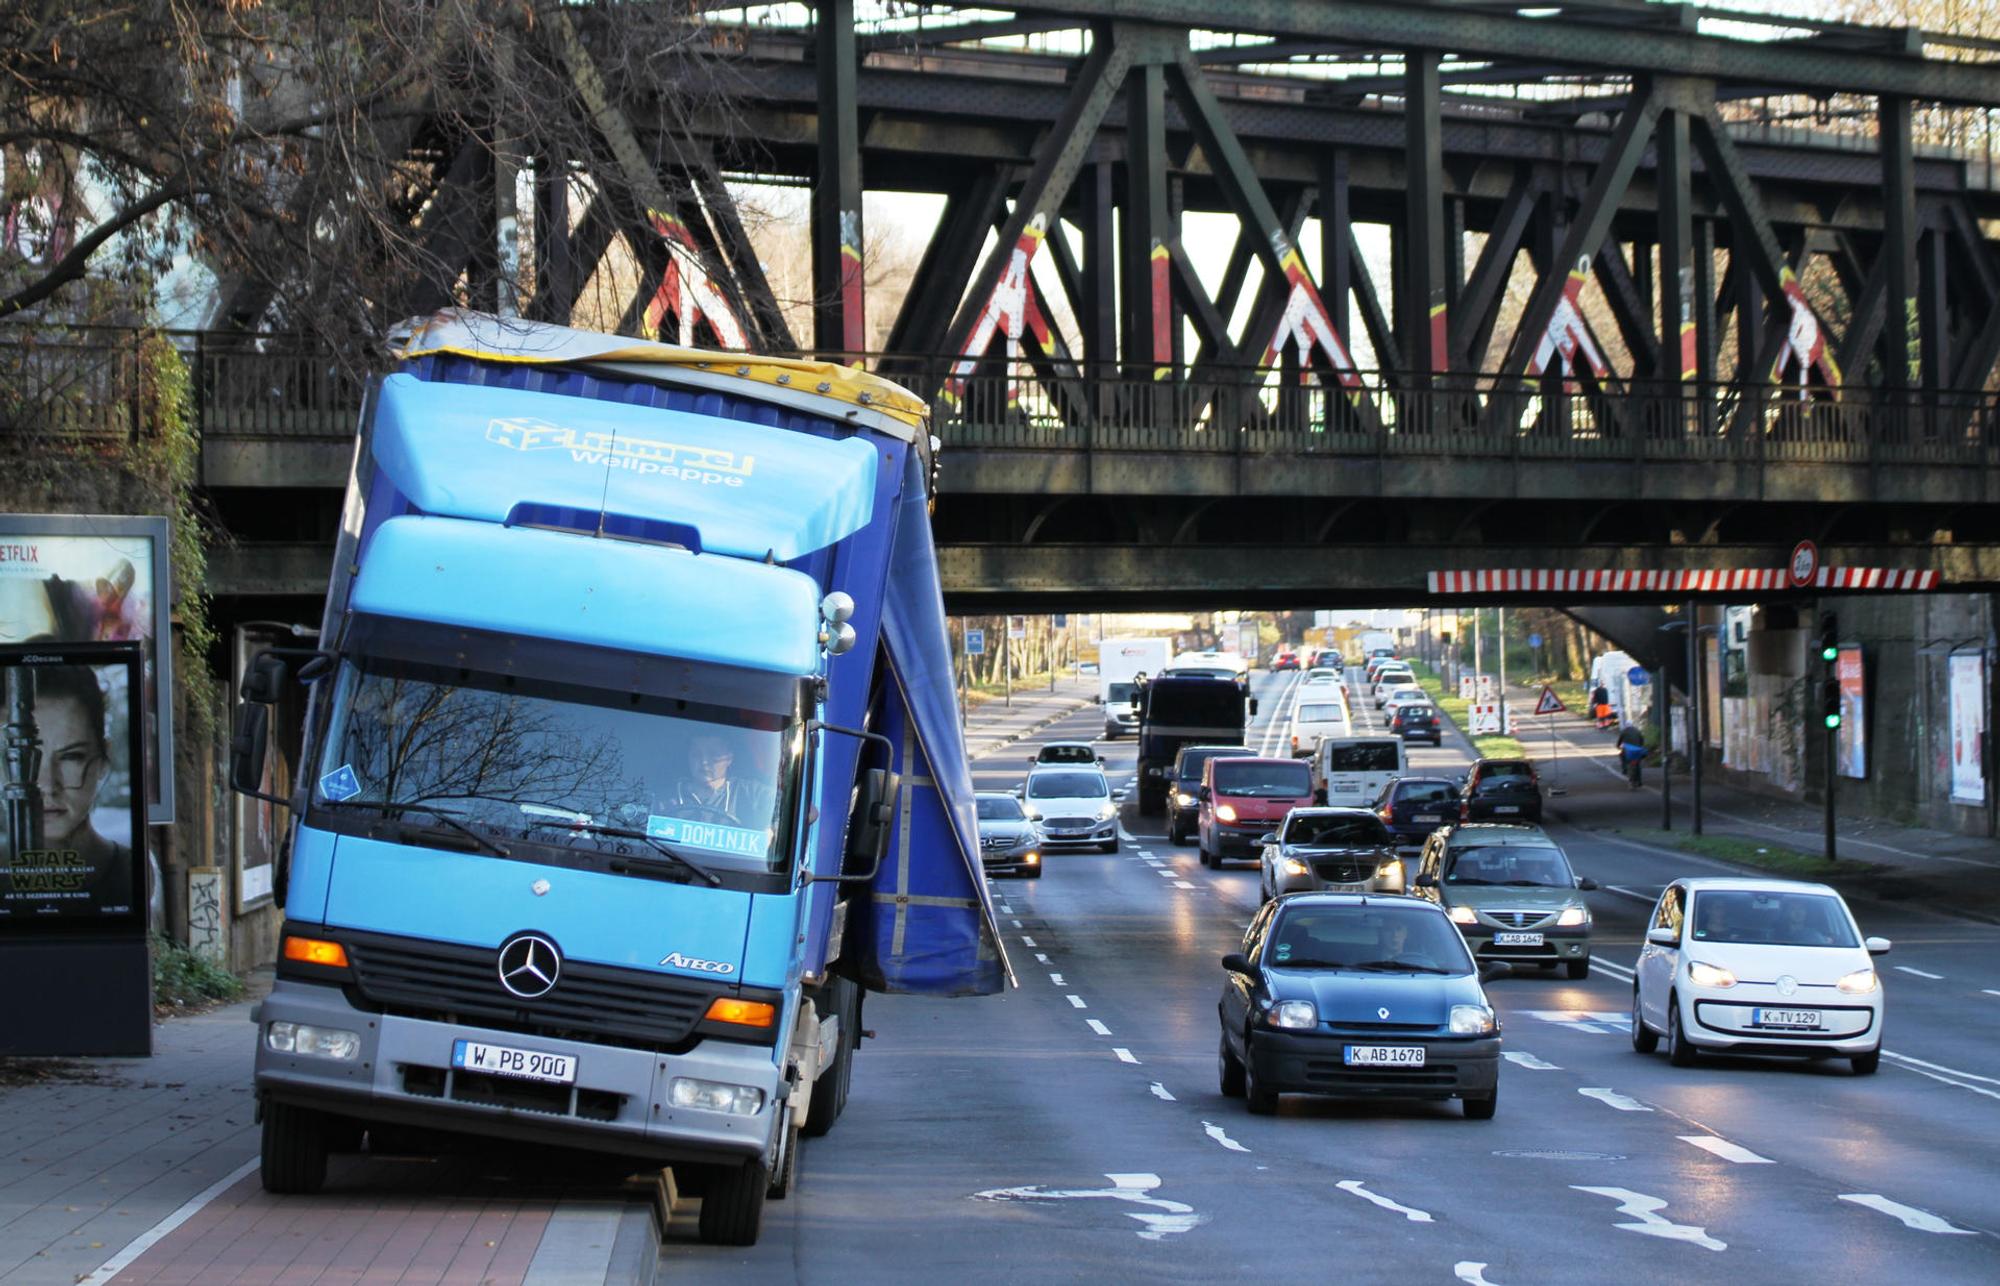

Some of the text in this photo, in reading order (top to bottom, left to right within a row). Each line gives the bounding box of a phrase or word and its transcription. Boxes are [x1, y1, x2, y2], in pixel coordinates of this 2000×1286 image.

[571, 449, 745, 488] Wellpappe
[0, 544, 38, 562] ETFLIX
[680, 823, 761, 852] DOMINIK
[9, 850, 85, 867] STAR
[9, 873, 85, 890] WARS
[1764, 1011, 1816, 1023] K TV 129
[474, 1046, 486, 1066] W
[500, 1050, 524, 1071] PB
[530, 1054, 566, 1077] 900
[1352, 1048, 1423, 1062] K AB 1678
